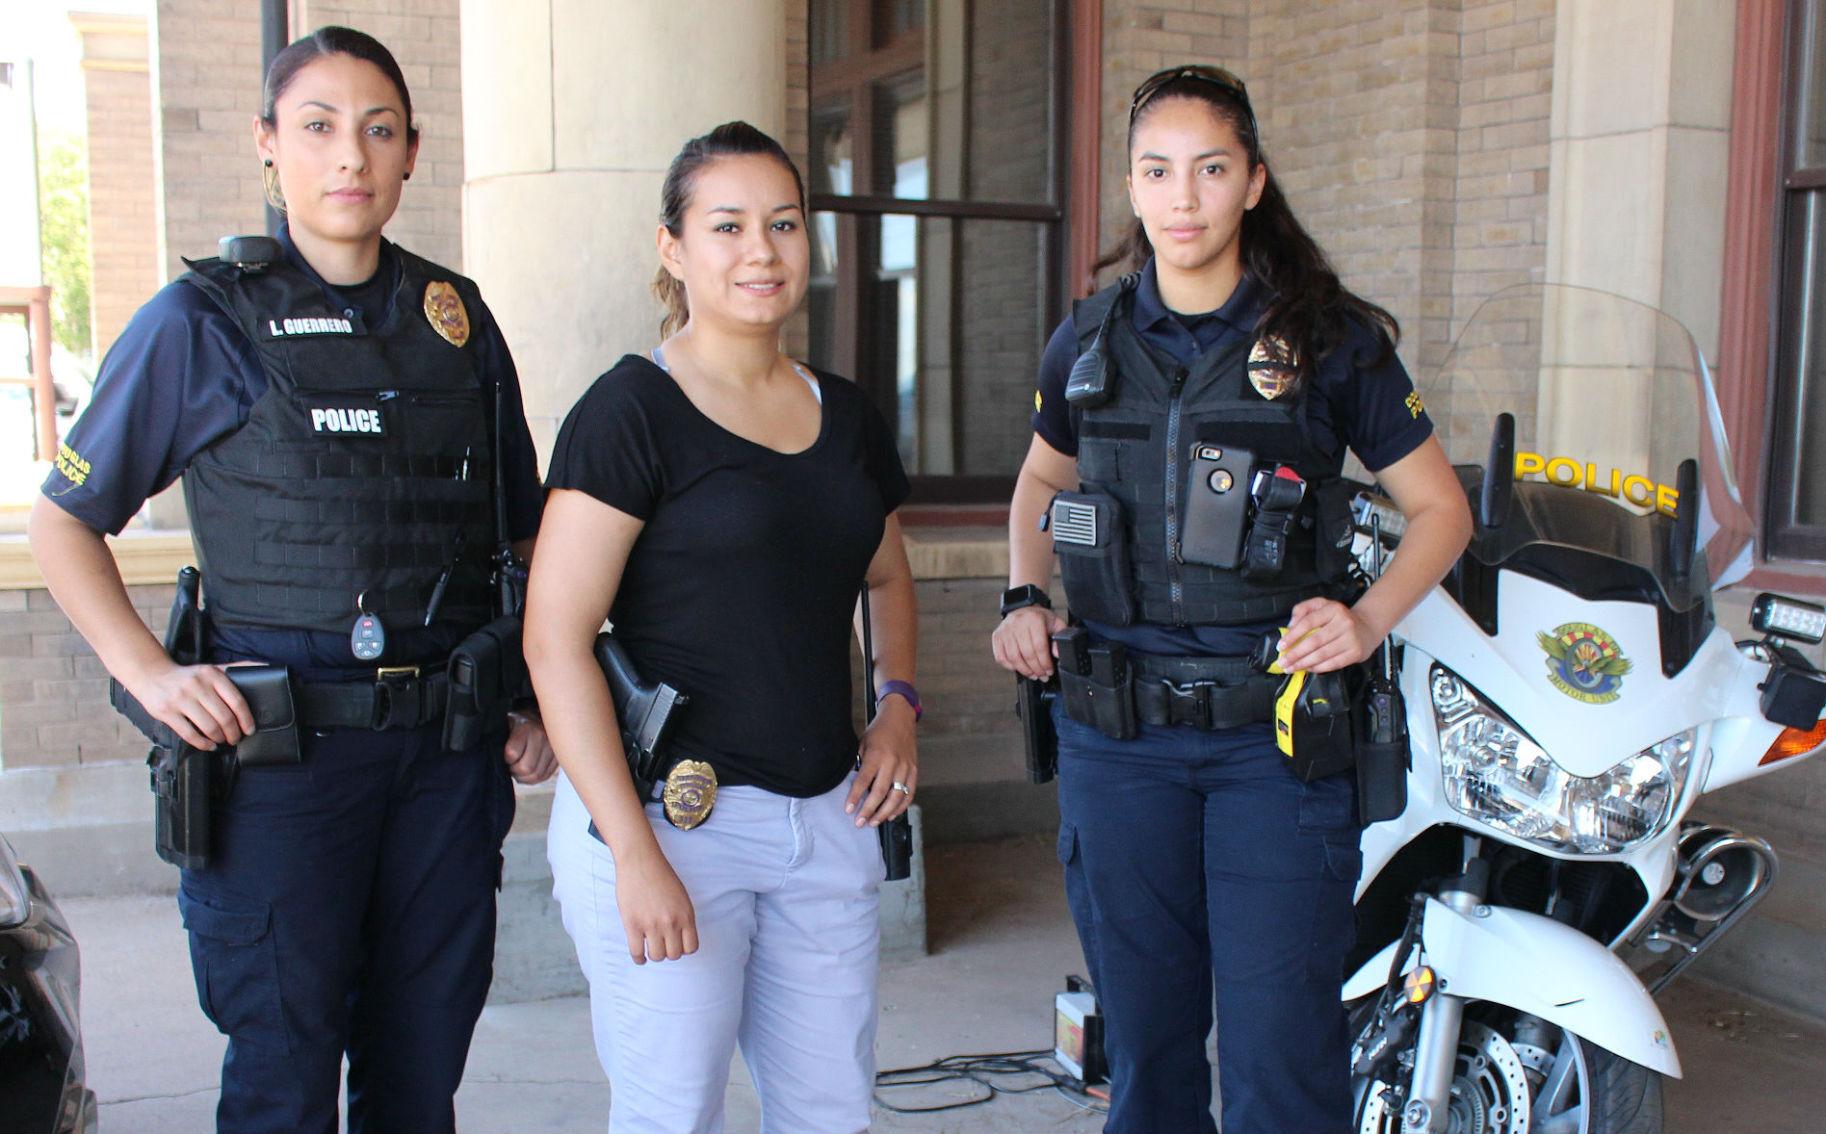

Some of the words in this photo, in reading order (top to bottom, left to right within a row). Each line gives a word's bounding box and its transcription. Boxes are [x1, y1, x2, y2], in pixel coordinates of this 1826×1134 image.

[269, 320, 283, 337] L.
[283, 318, 353, 335] GUERRERO
[311, 408, 381, 433] POLICE
[1514, 452, 1680, 519] POLICE
